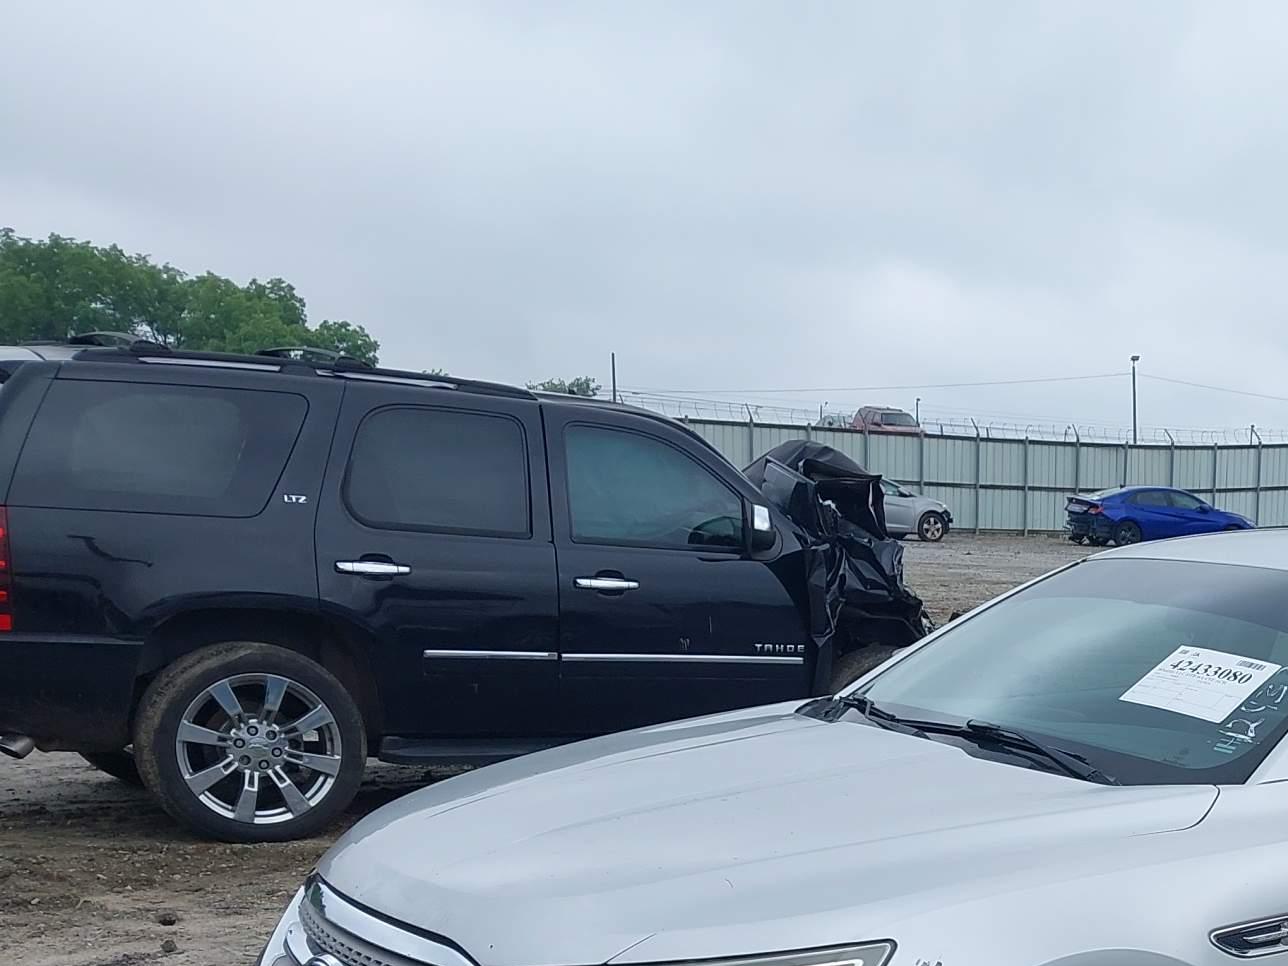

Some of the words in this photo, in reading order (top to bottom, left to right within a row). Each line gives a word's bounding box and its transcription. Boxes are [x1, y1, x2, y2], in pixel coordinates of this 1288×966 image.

[283, 494, 308, 504] LTZ
[754, 643, 806, 653] TAHOE
[1169, 659, 1254, 685] 42433080
